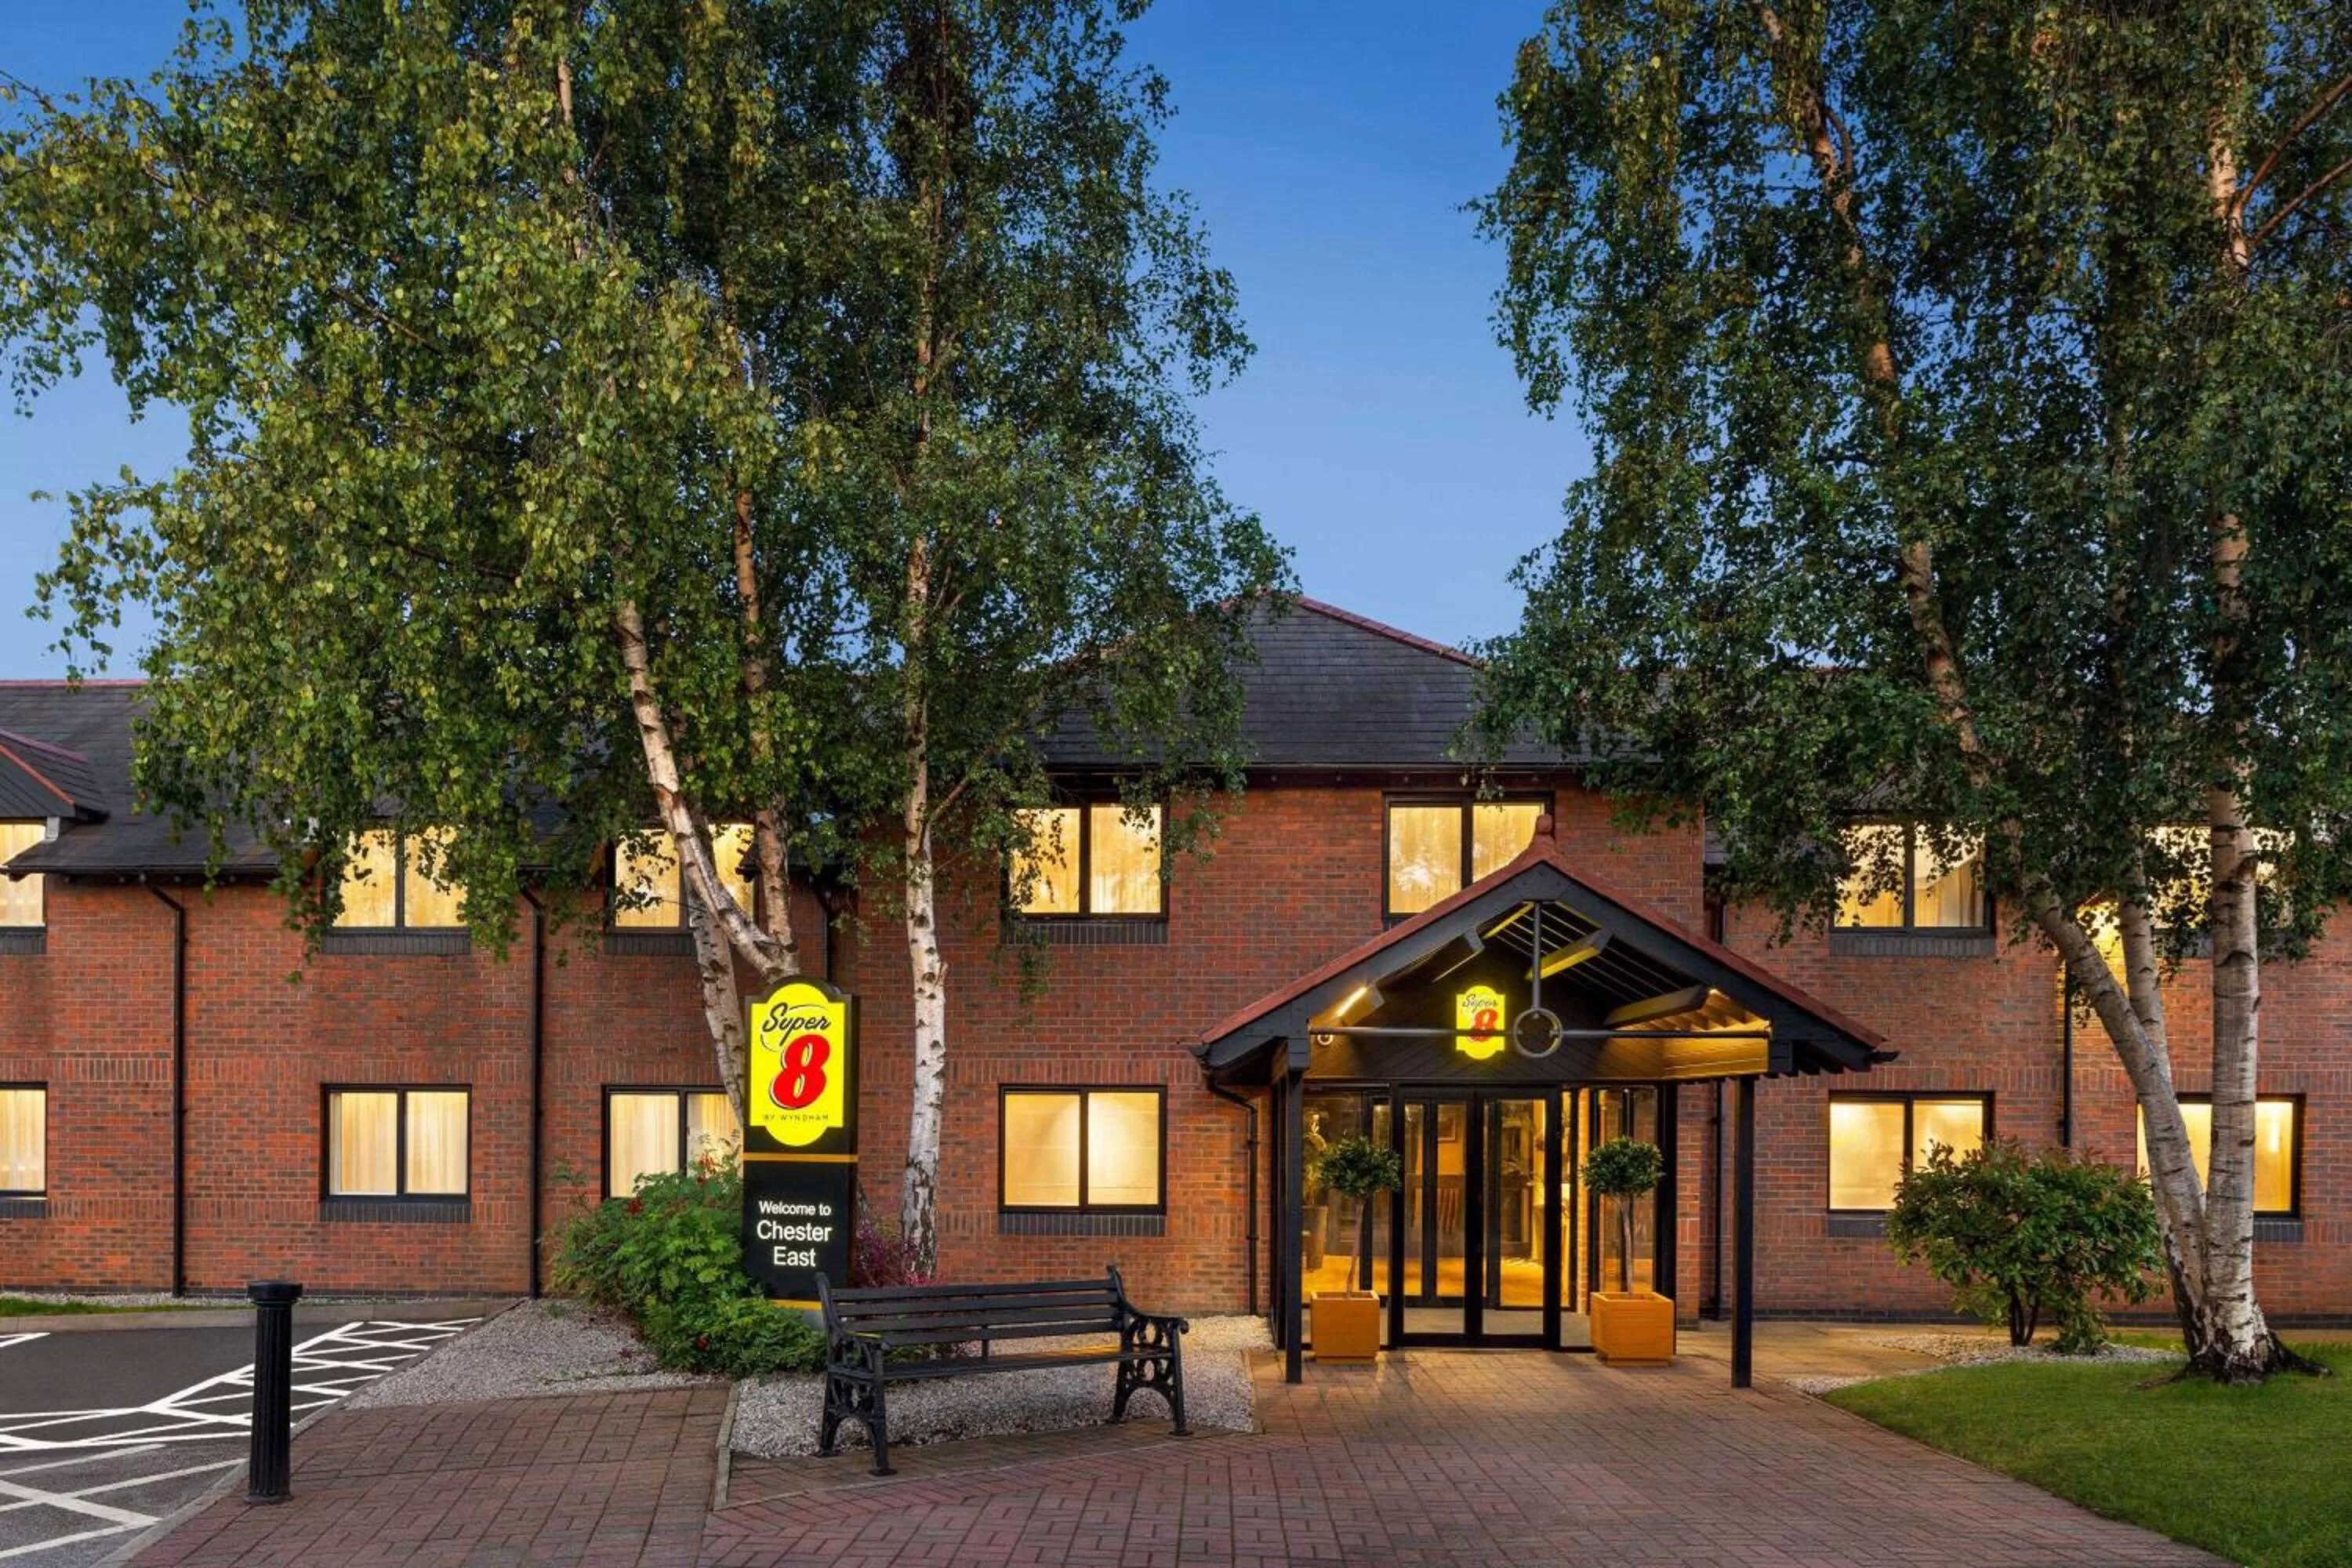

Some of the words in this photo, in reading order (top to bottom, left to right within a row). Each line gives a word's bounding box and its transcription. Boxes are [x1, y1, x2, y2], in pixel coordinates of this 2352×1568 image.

[762, 1002, 832, 1046] Super
[770, 1034, 831, 1110] 8
[759, 1200, 816, 1215] Welcome
[818, 1203, 832, 1216] to
[757, 1219, 833, 1242] Chester
[773, 1246, 816, 1267] East
